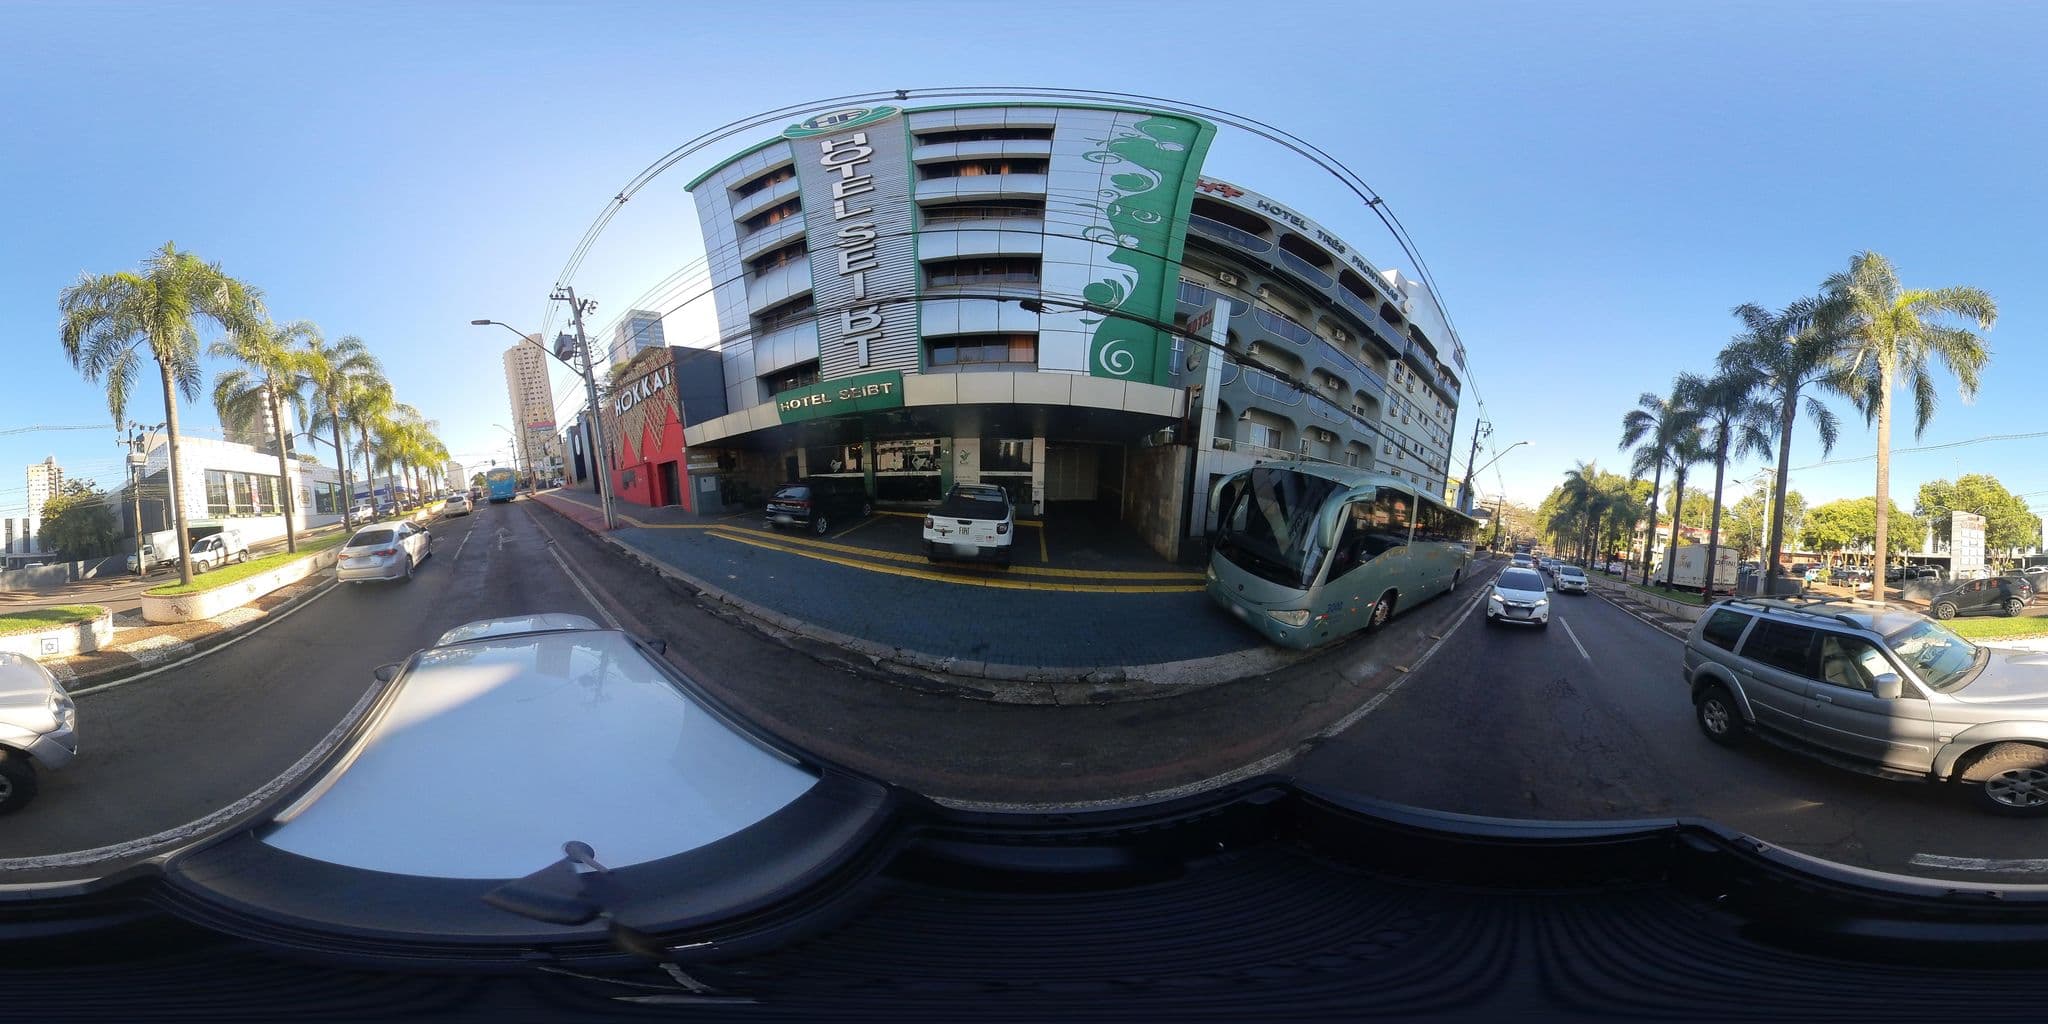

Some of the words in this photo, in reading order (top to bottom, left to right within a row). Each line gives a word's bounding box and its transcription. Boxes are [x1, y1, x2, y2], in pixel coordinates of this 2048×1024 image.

[820, 132, 875, 221] HOTEL
[1257, 200, 1308, 230] HOTEL
[836, 222, 883, 368] SEIBT
[615, 365, 671, 417] HOKKAI
[780, 393, 832, 412] HOTEL
[839, 382, 893, 400] SEIBT
